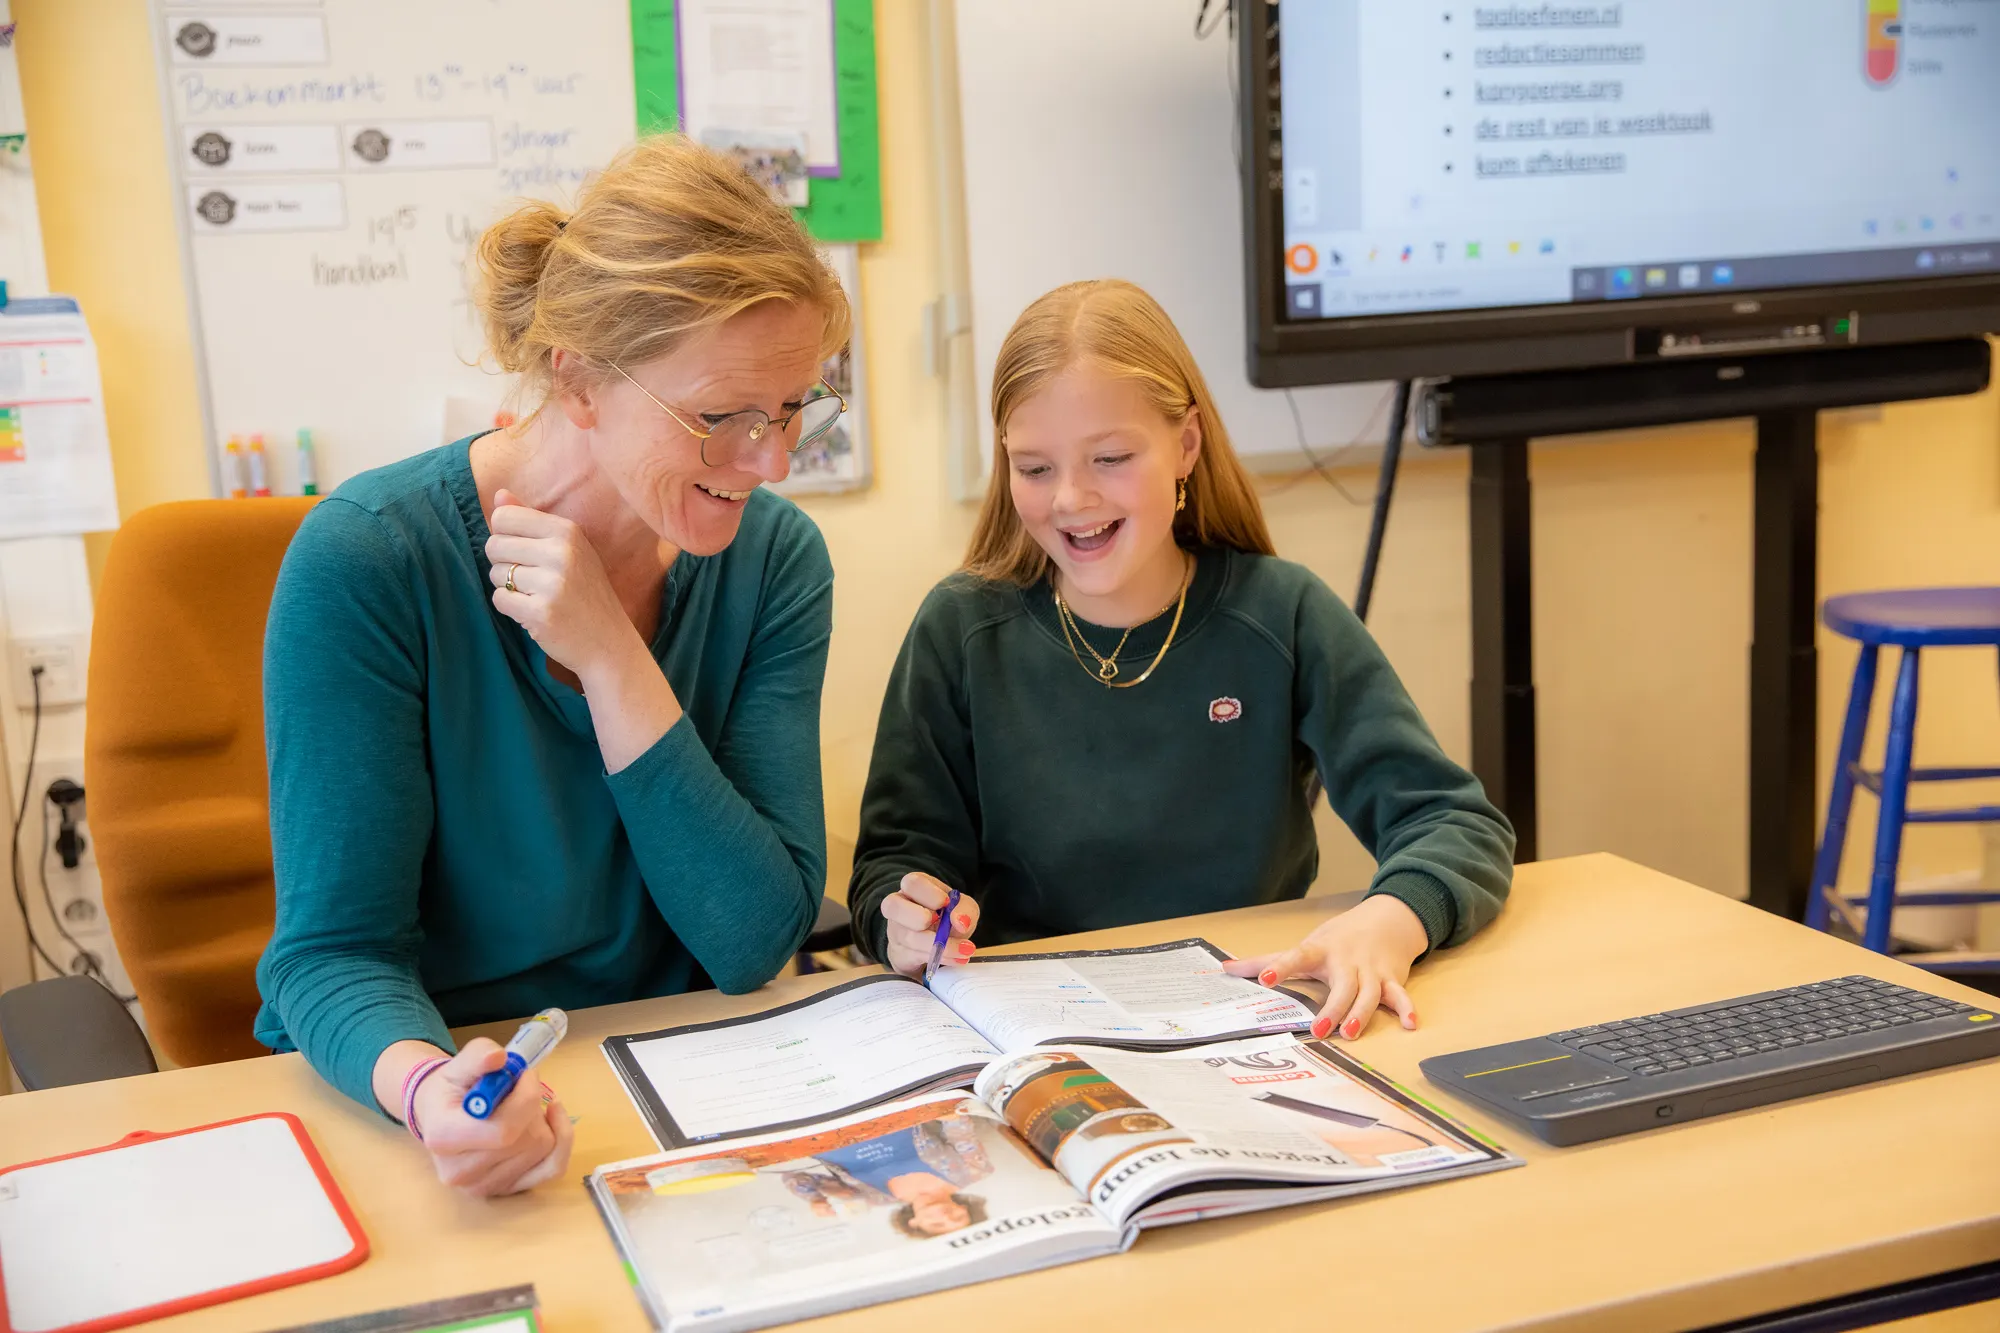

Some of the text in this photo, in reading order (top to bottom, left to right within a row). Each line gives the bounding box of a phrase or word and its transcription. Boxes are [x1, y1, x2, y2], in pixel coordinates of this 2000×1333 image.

[1475, 115, 1501, 140] de
[1255, 1010, 1303, 1023] OPGELICHT
[1234, 1072, 1314, 1084] Column
[948, 1147, 1348, 1249] Tegen de lamp gelopen
